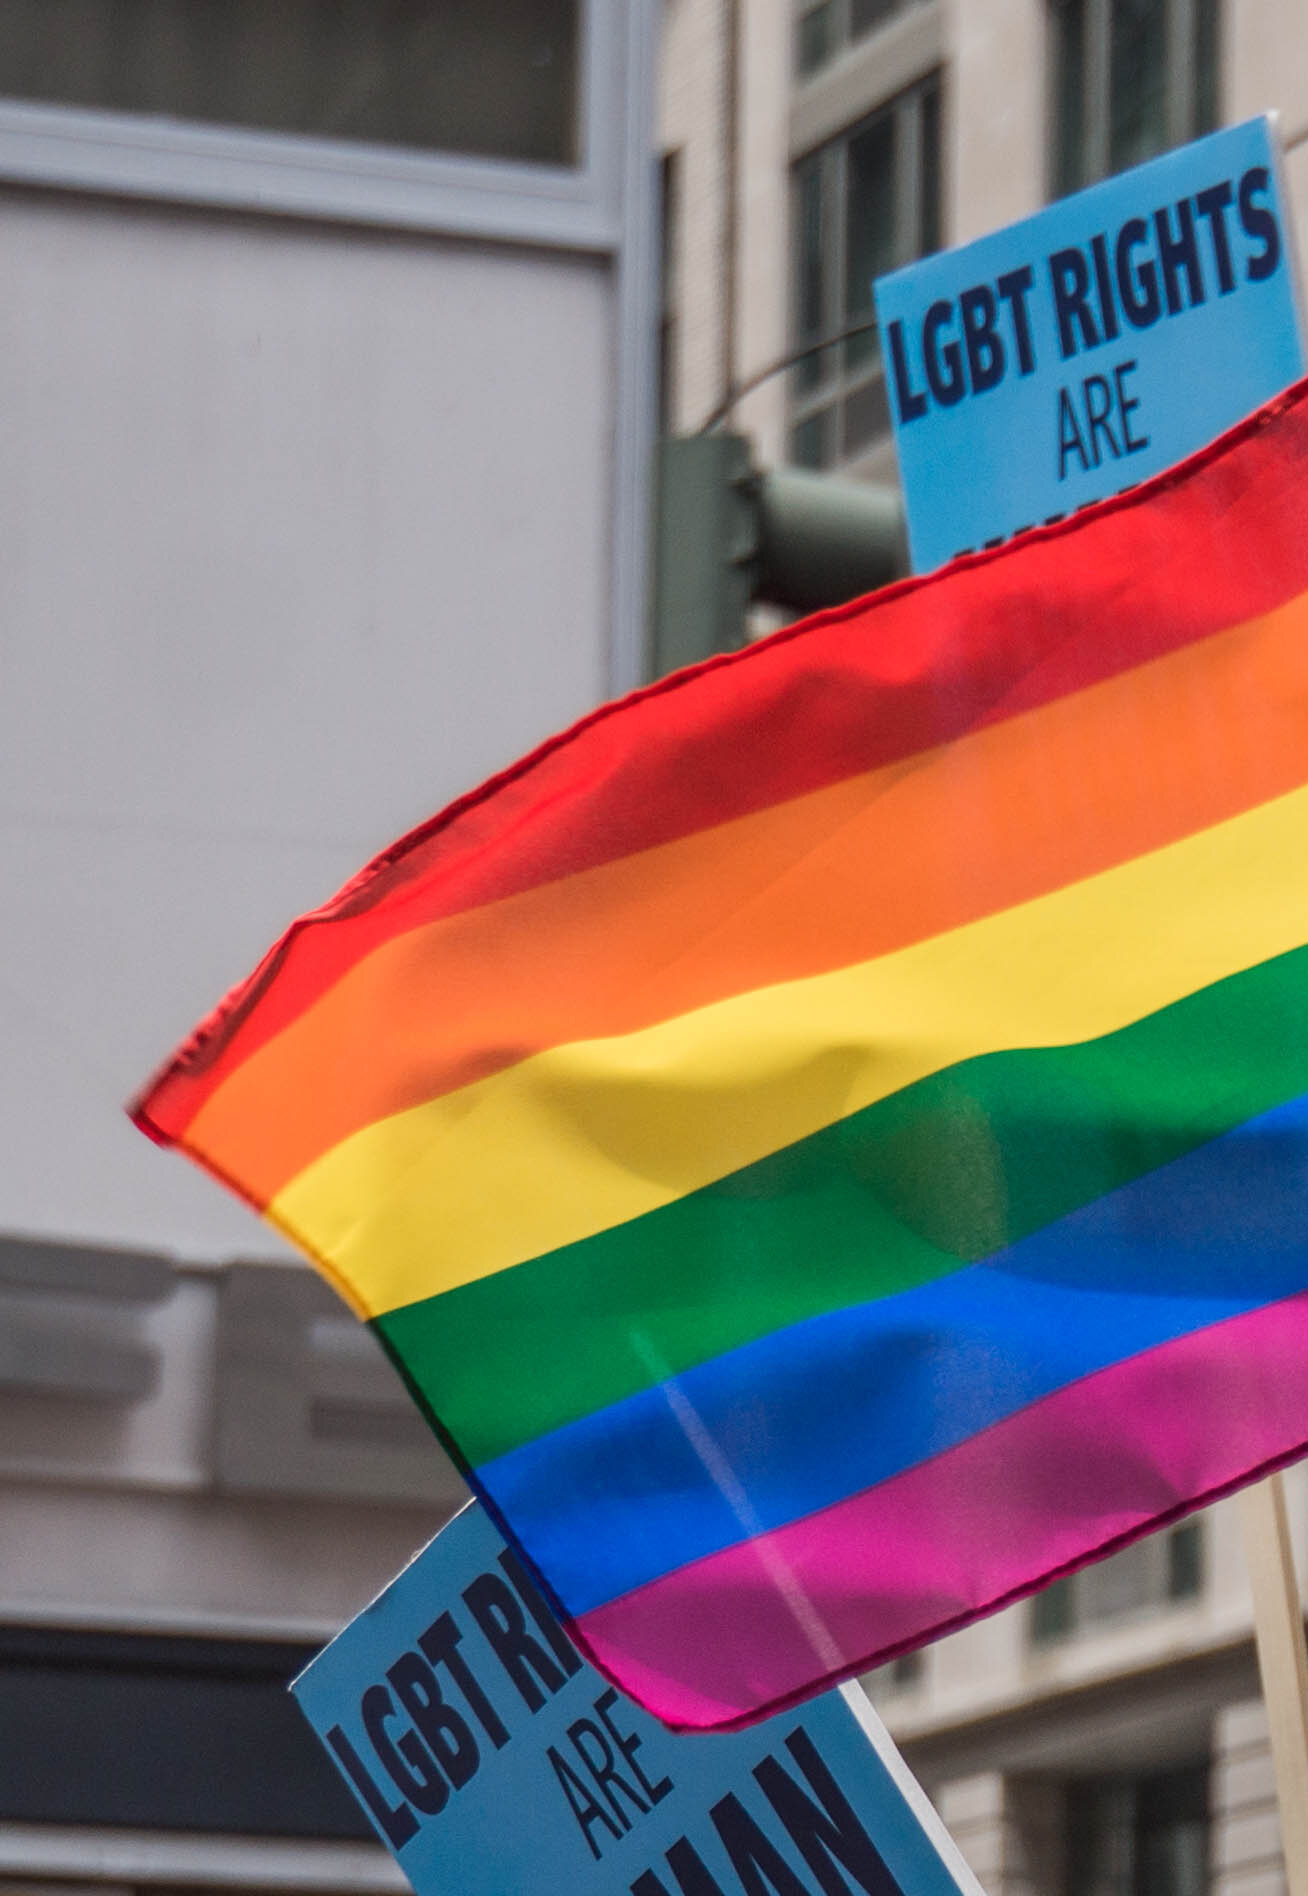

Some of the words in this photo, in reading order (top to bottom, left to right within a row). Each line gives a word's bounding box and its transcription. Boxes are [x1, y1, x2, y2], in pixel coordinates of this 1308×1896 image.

[888, 266, 1035, 424] LGBT
[1049, 167, 1281, 361] RIGHTS
[1059, 360, 1150, 481] ARE
[326, 1613, 511, 1851] LGBT
[545, 1686, 674, 1860] ARE
